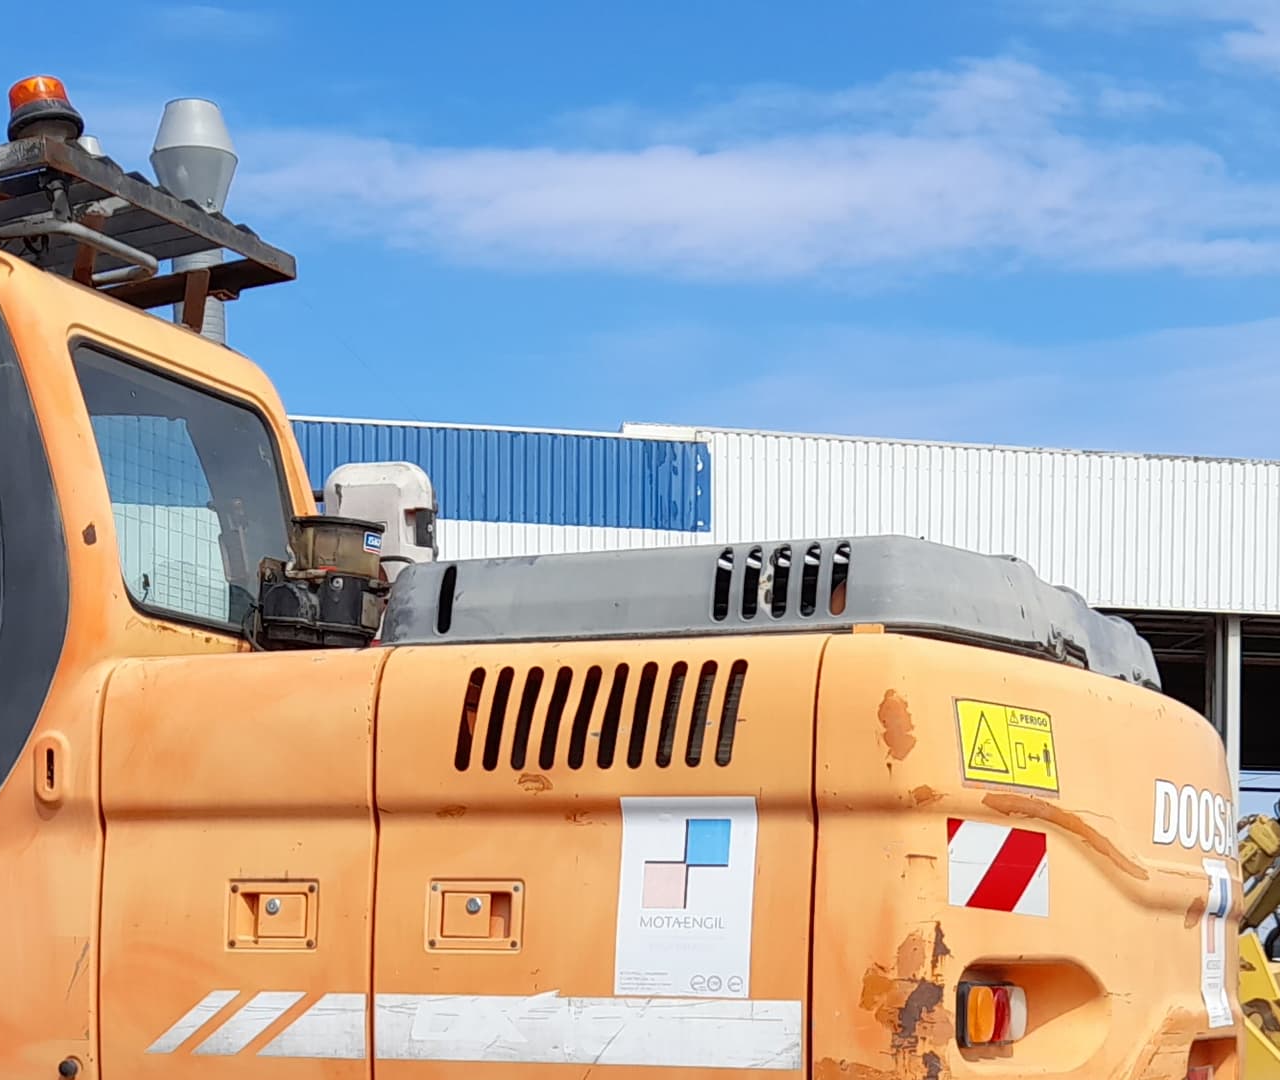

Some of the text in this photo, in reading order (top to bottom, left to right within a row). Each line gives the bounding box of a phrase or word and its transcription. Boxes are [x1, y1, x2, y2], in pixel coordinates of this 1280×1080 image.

[1020, 713, 1048, 727] PERIGO
[1153, 778, 1236, 859] DOOSA
[639, 915, 726, 930] MOTA-ENGIL
